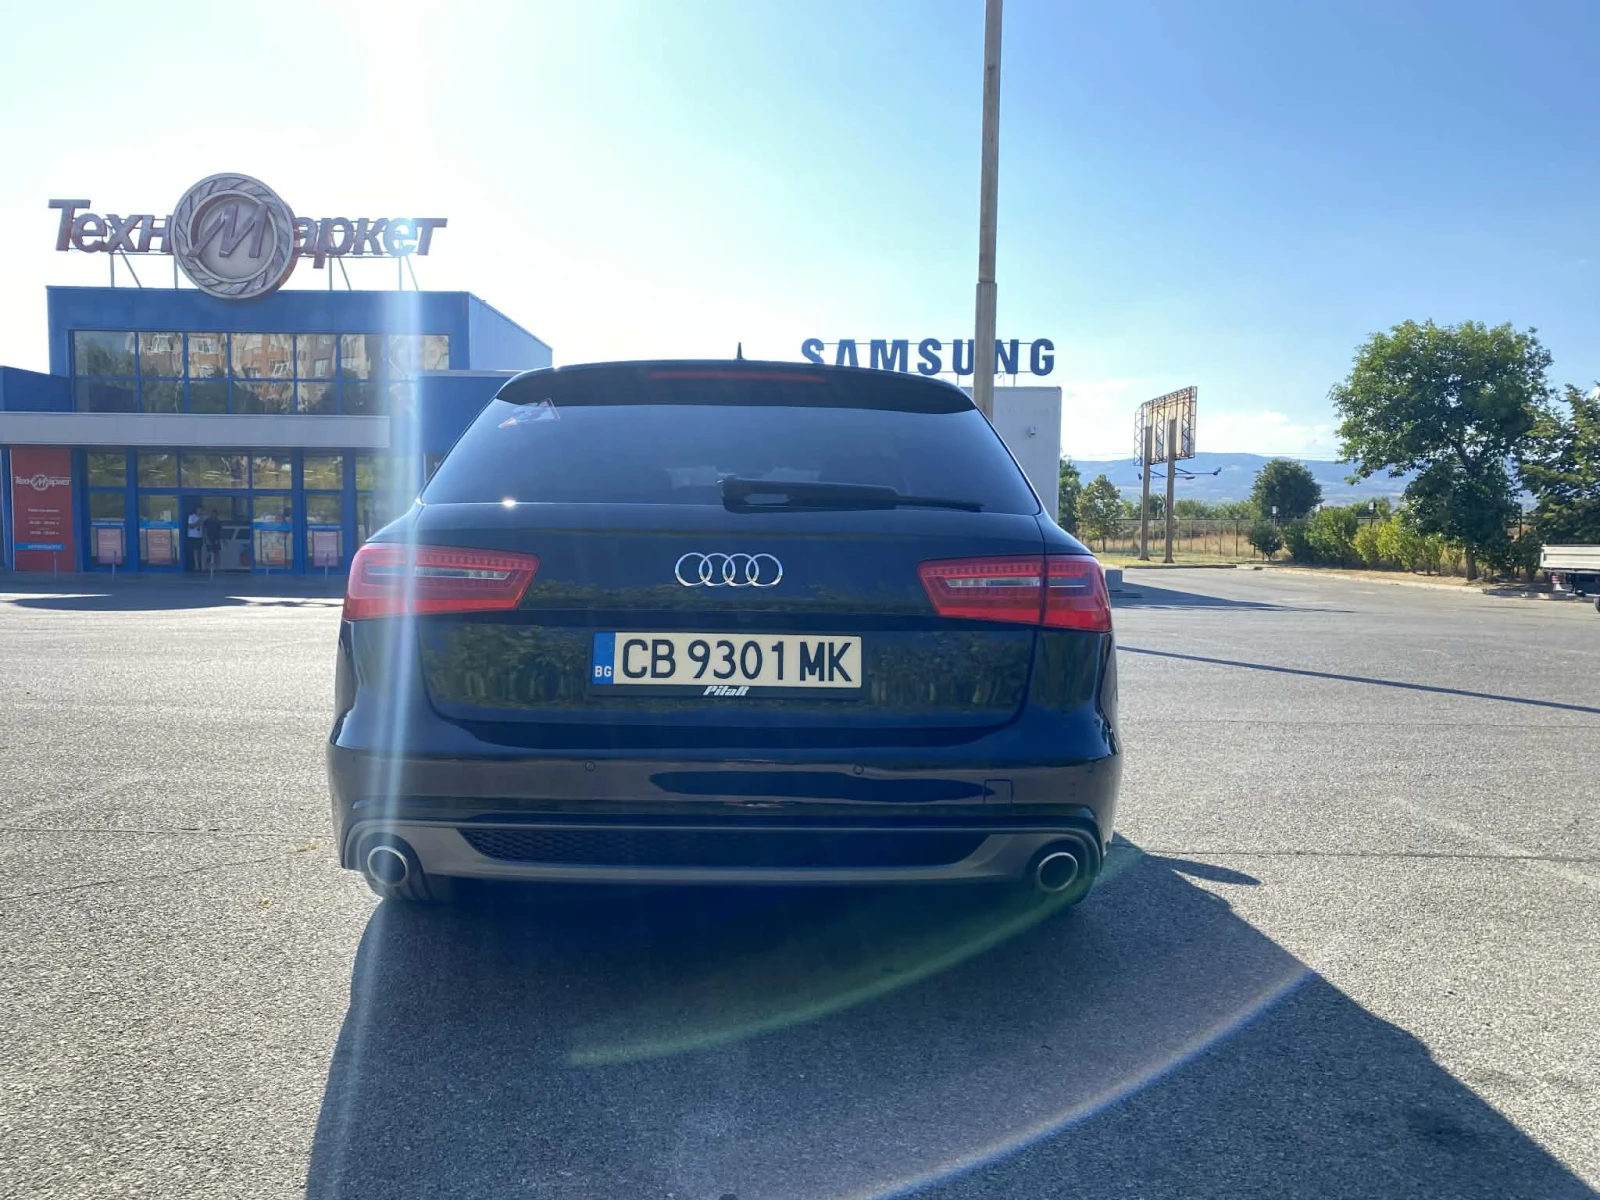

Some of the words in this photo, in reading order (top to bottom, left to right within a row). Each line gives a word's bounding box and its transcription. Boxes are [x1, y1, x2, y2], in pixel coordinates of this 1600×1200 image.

[801, 338, 1055, 376] SAMSUNG
[594, 665, 612, 678] BG
[622, 638, 677, 679] CB
[687, 639, 785, 681] 9301
[799, 641, 853, 683] MK
